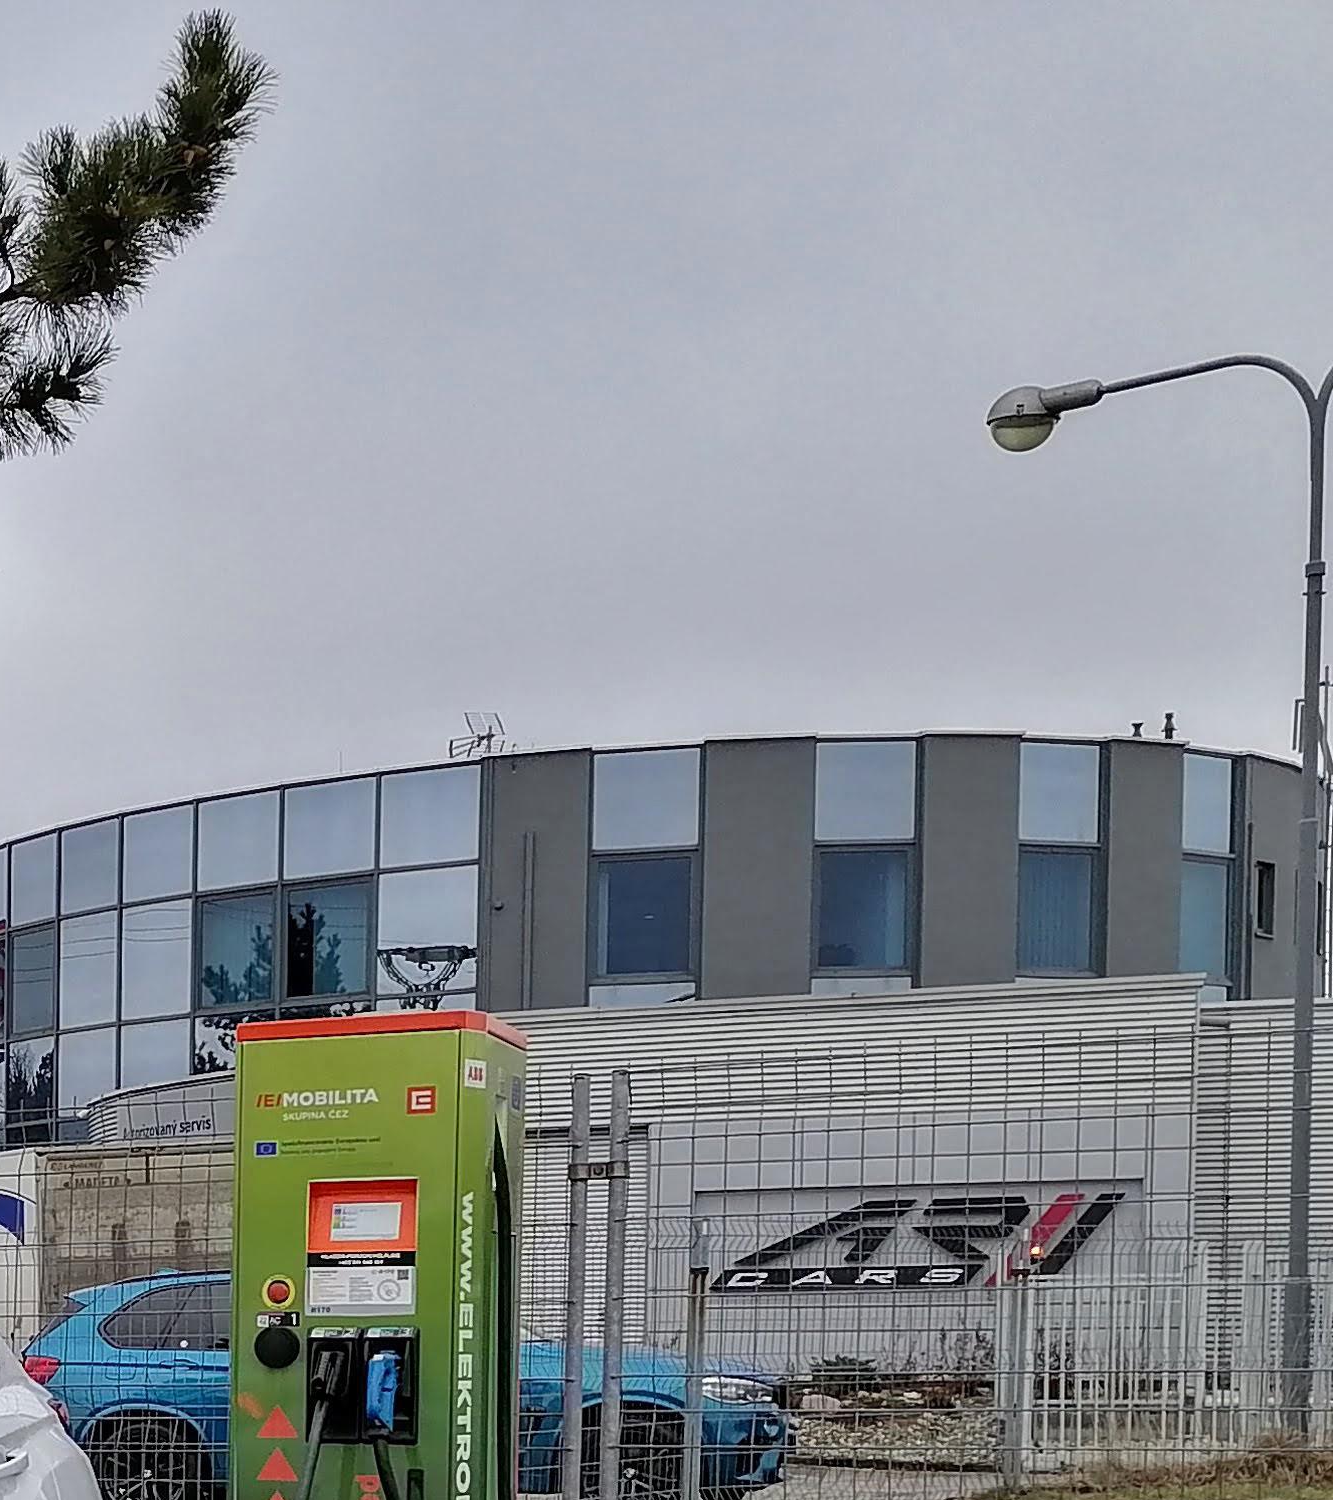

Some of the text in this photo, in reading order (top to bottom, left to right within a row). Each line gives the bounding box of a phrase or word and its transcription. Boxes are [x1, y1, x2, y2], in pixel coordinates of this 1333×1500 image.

[179, 1115, 212, 1134] servis
[282, 1109, 350, 1122] SKUPINA ČEZ
[725, 1268, 966, 1288] CARS
